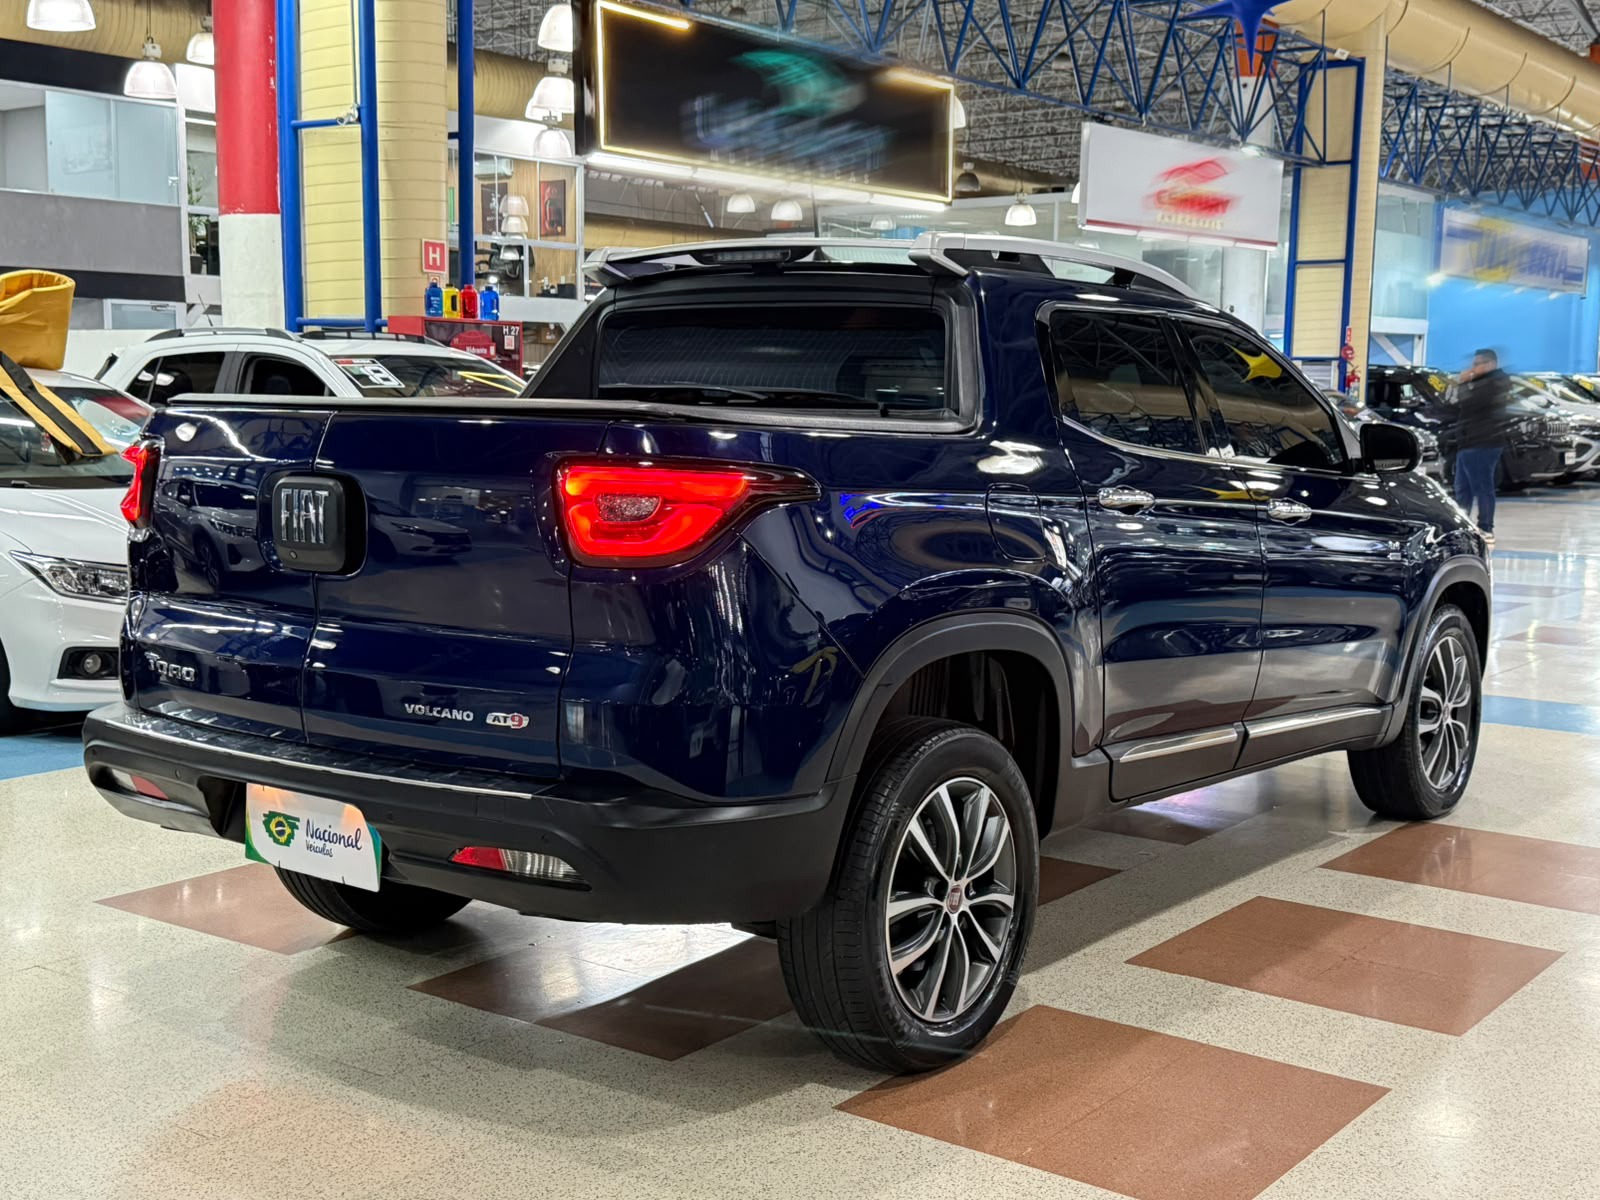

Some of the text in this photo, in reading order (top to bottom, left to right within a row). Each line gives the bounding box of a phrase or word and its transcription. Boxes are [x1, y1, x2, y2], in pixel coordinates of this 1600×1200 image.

[429, 246, 440, 266] H
[503, 325, 520, 335] H 27
[281, 488, 329, 543] FIAT
[144, 651, 195, 681] TORO
[404, 703, 524, 729] VOLCANO AT9
[305, 818, 363, 851] Nacional
